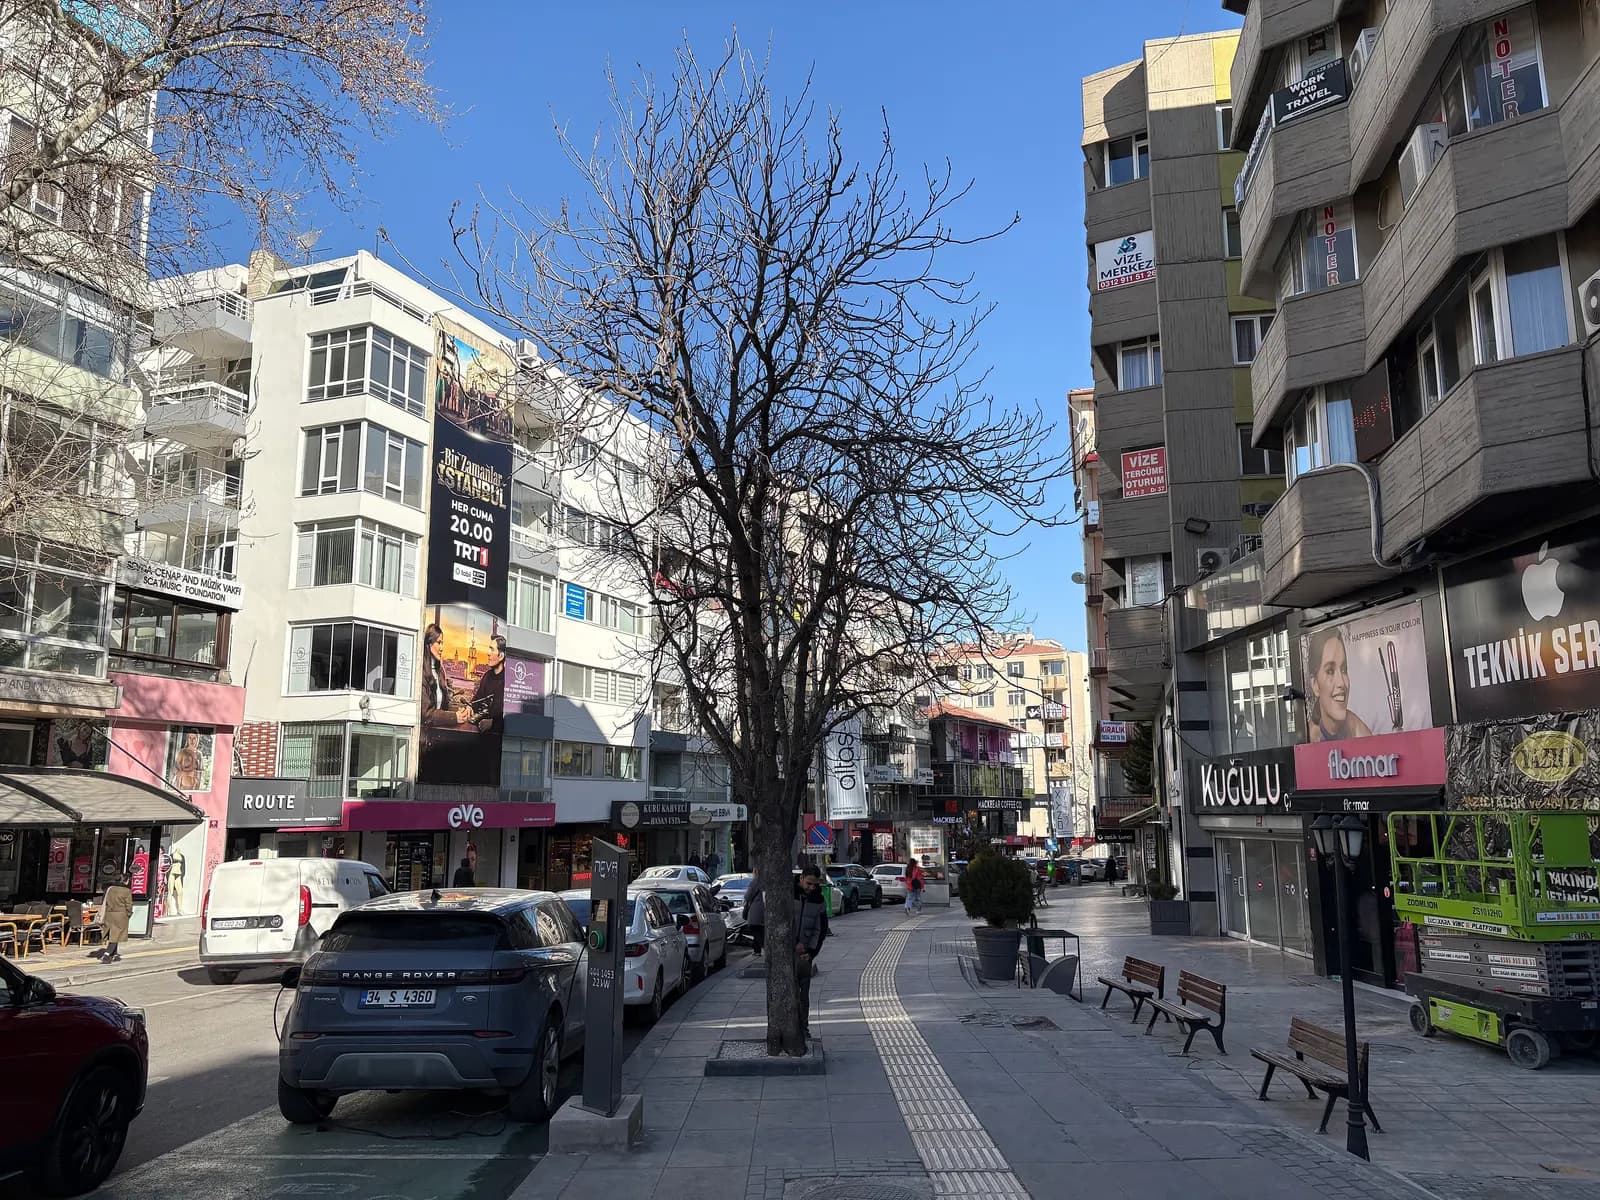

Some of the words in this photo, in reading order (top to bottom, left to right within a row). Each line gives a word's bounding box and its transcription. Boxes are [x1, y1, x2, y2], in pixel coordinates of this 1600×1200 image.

[1494, 18, 1520, 120] NOTER
[1289, 72, 1326, 93] WORK
[1298, 84, 1317, 97] AND
[1285, 87, 1332, 111] TRAVEL
[1324, 206, 1340, 287] NOTER
[1114, 252, 1142, 266] VİZE
[1100, 279, 1118, 288] 0312
[1120, 276, 1133, 284] 911
[444, 447, 460, 470] Bir
[458, 453, 503, 486] Zamanlar
[1129, 453, 1159, 468] VİZE
[1125, 466, 1164, 478] TERCÜME
[1126, 476, 1164, 489] OTURUM
[451, 499, 469, 514] HER
[470, 507, 494, 524] CUMA
[450, 515, 493, 543] 20.00
[143, 576, 158, 587] SCA
[160, 580, 182, 592] MUSIC
[185, 586, 226, 602] FOUNDATION
[182, 574, 199, 586] AND
[201, 578, 221, 591] MÜZİK
[222, 584, 242, 596] VAKFI
[1352, 629, 1379, 642] HAPPINESS
[1380, 627, 1385, 635] IS
[1385, 624, 1401, 634] YOUR
[1401, 618, 1421, 629] COLOR
[1464, 628, 1546, 689] TEKNİK
[1328, 749, 1400, 779] flormar
[1201, 759, 1281, 806] KUĞULU
[243, 794, 296, 809] ROUTE
[448, 804, 484, 828] eve
[933, 816, 963, 824] MACKBEAR
[1407, 898, 1438, 909] ZOOMLION
[1471, 923, 1502, 932] PLATFORM
[367, 991, 381, 1003] 34
[389, 991, 398, 1003] S
[403, 991, 433, 1003] 4360
